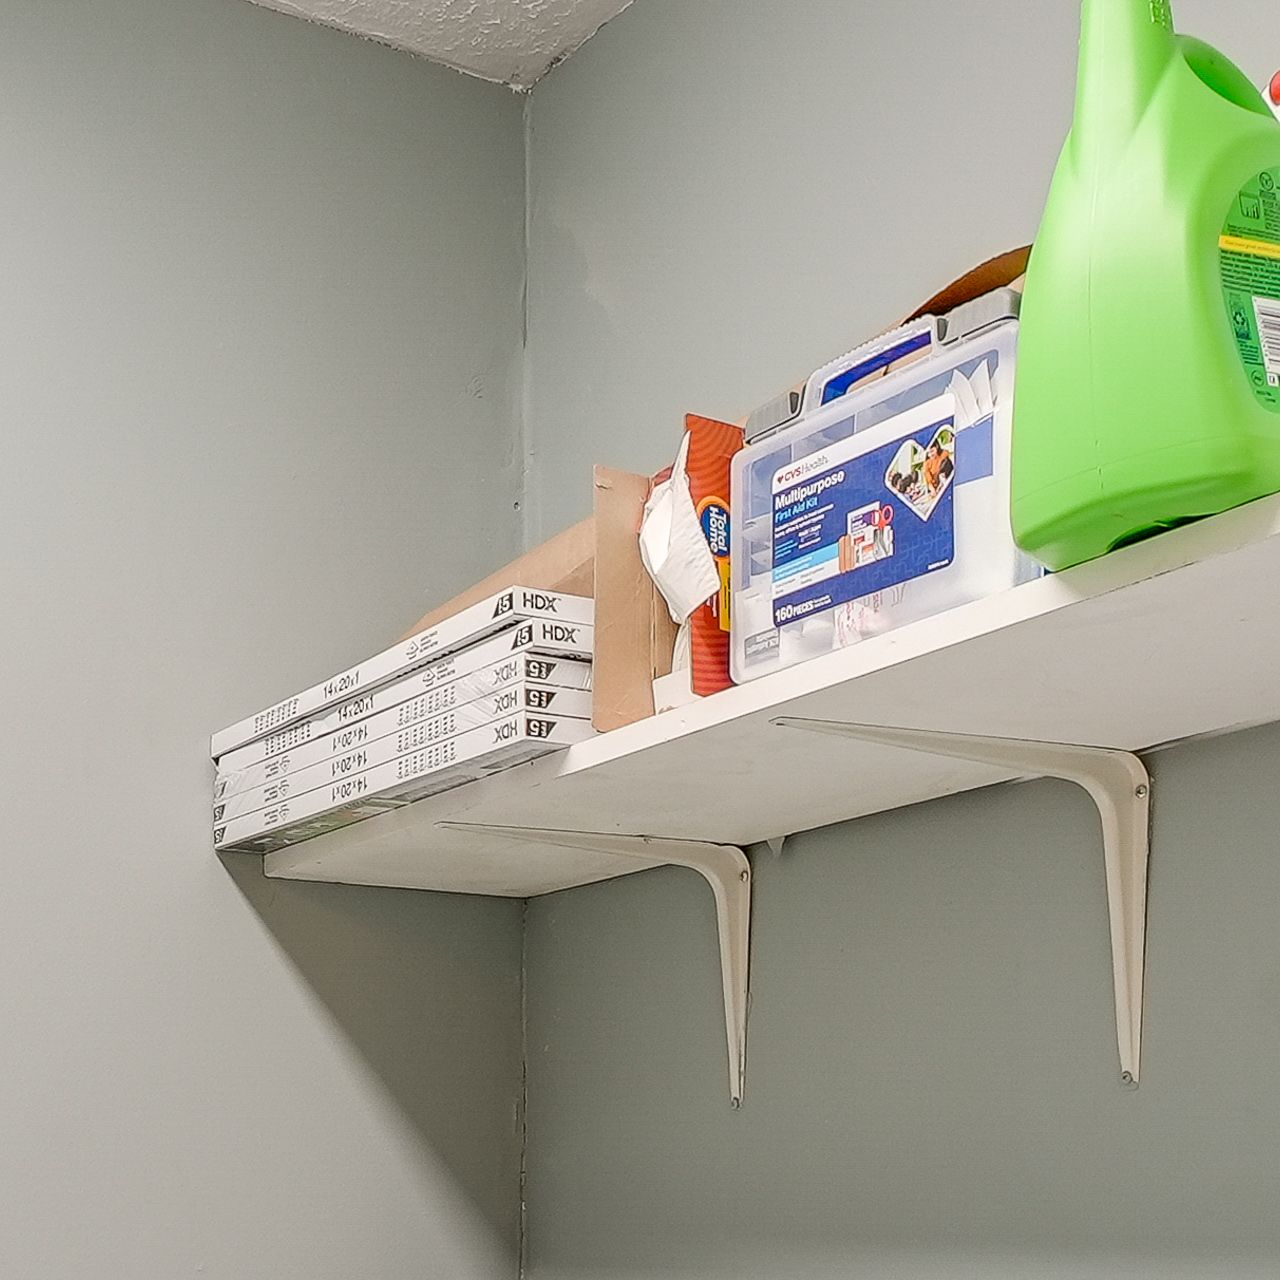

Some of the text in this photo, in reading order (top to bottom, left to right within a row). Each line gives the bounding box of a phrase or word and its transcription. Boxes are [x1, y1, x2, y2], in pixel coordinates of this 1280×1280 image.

[774, 470, 846, 511] Multipurpose
[709, 506, 718, 553] Home
[717, 512, 728, 553] Total
[522, 592, 558, 613] HDX
[775, 604, 793, 622] 160
[542, 624, 578, 644] HDX
[323, 670, 360, 699] 14x20x1
[337, 694, 374, 723] 14x20x1
